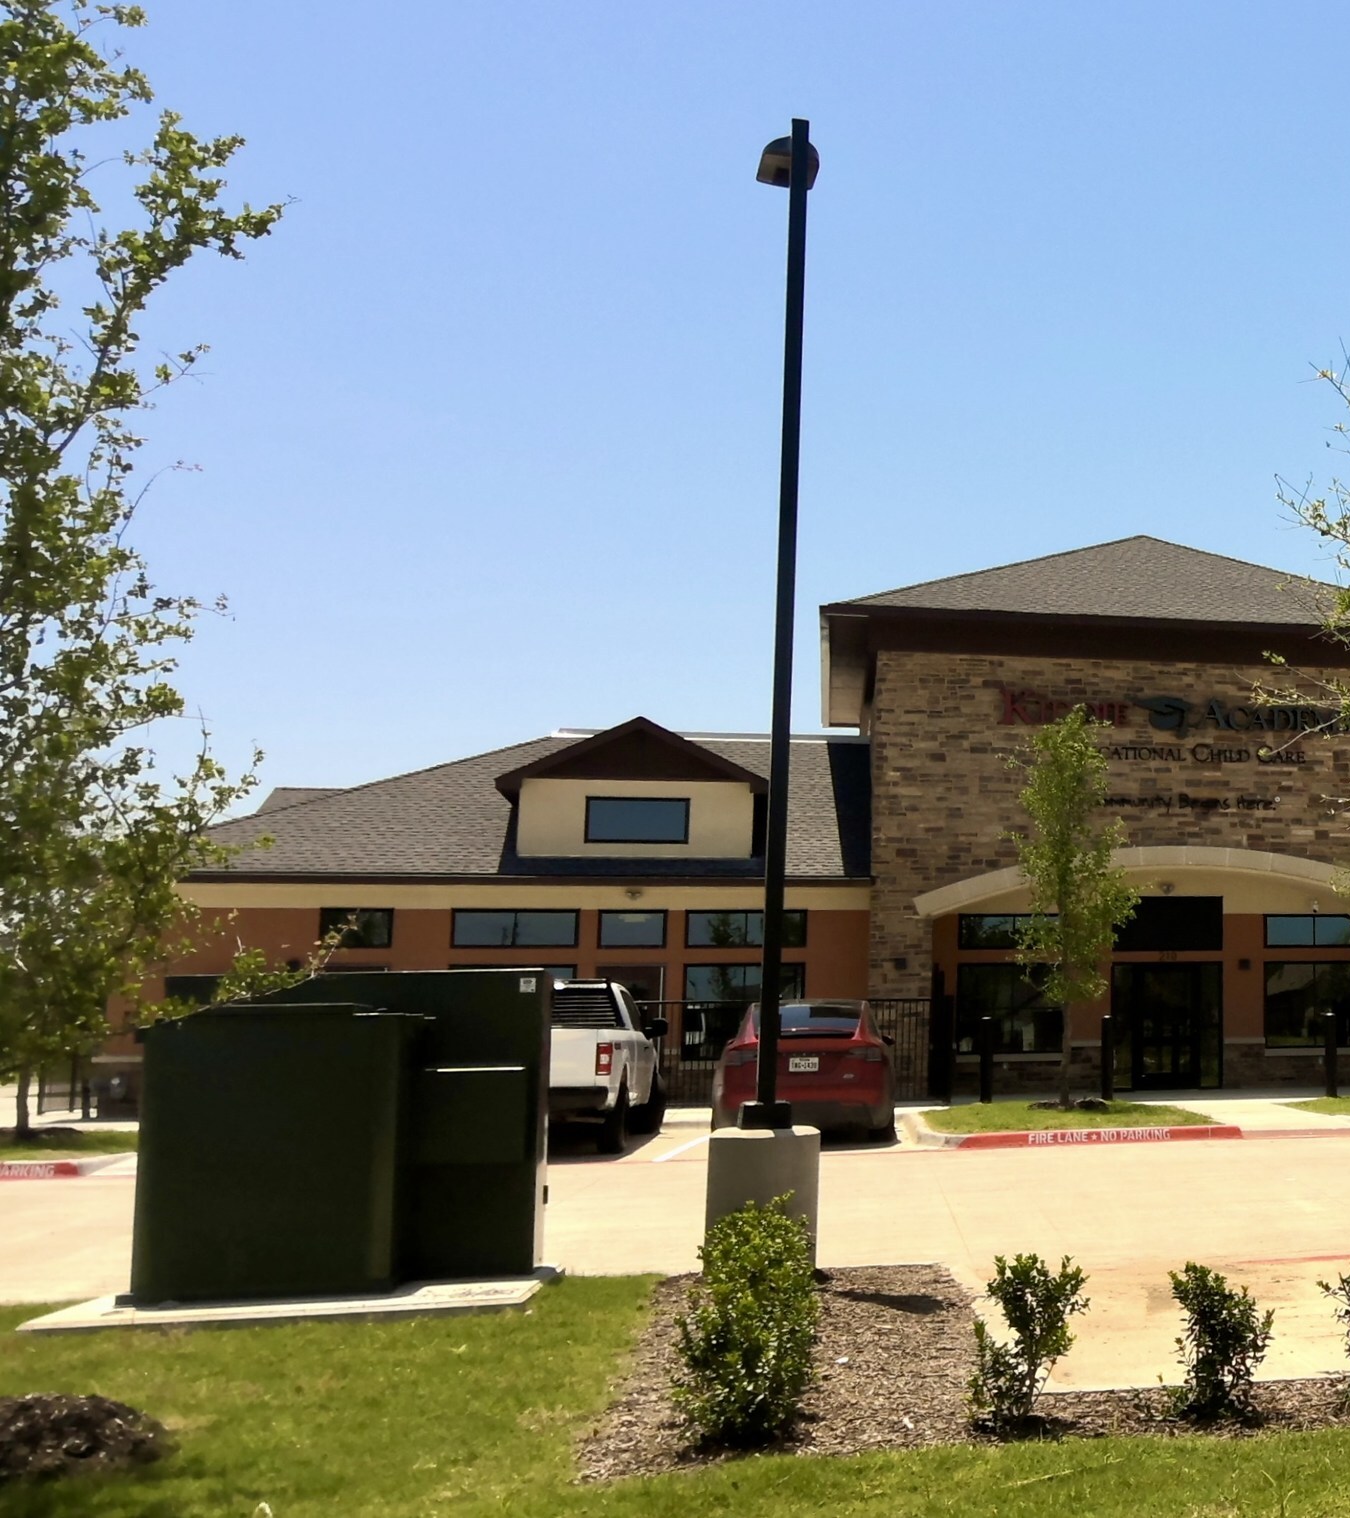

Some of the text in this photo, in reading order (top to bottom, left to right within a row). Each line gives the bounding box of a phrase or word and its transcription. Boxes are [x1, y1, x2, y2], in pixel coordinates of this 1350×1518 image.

[1100, 743, 1306, 764] CATIONAL CHILD CARE
[1104, 796, 1171, 813] mmunity
[1028, 1128, 1170, 1144] FIRE LANE NO PARKING
[0, 1164, 55, 1177] ARKING
